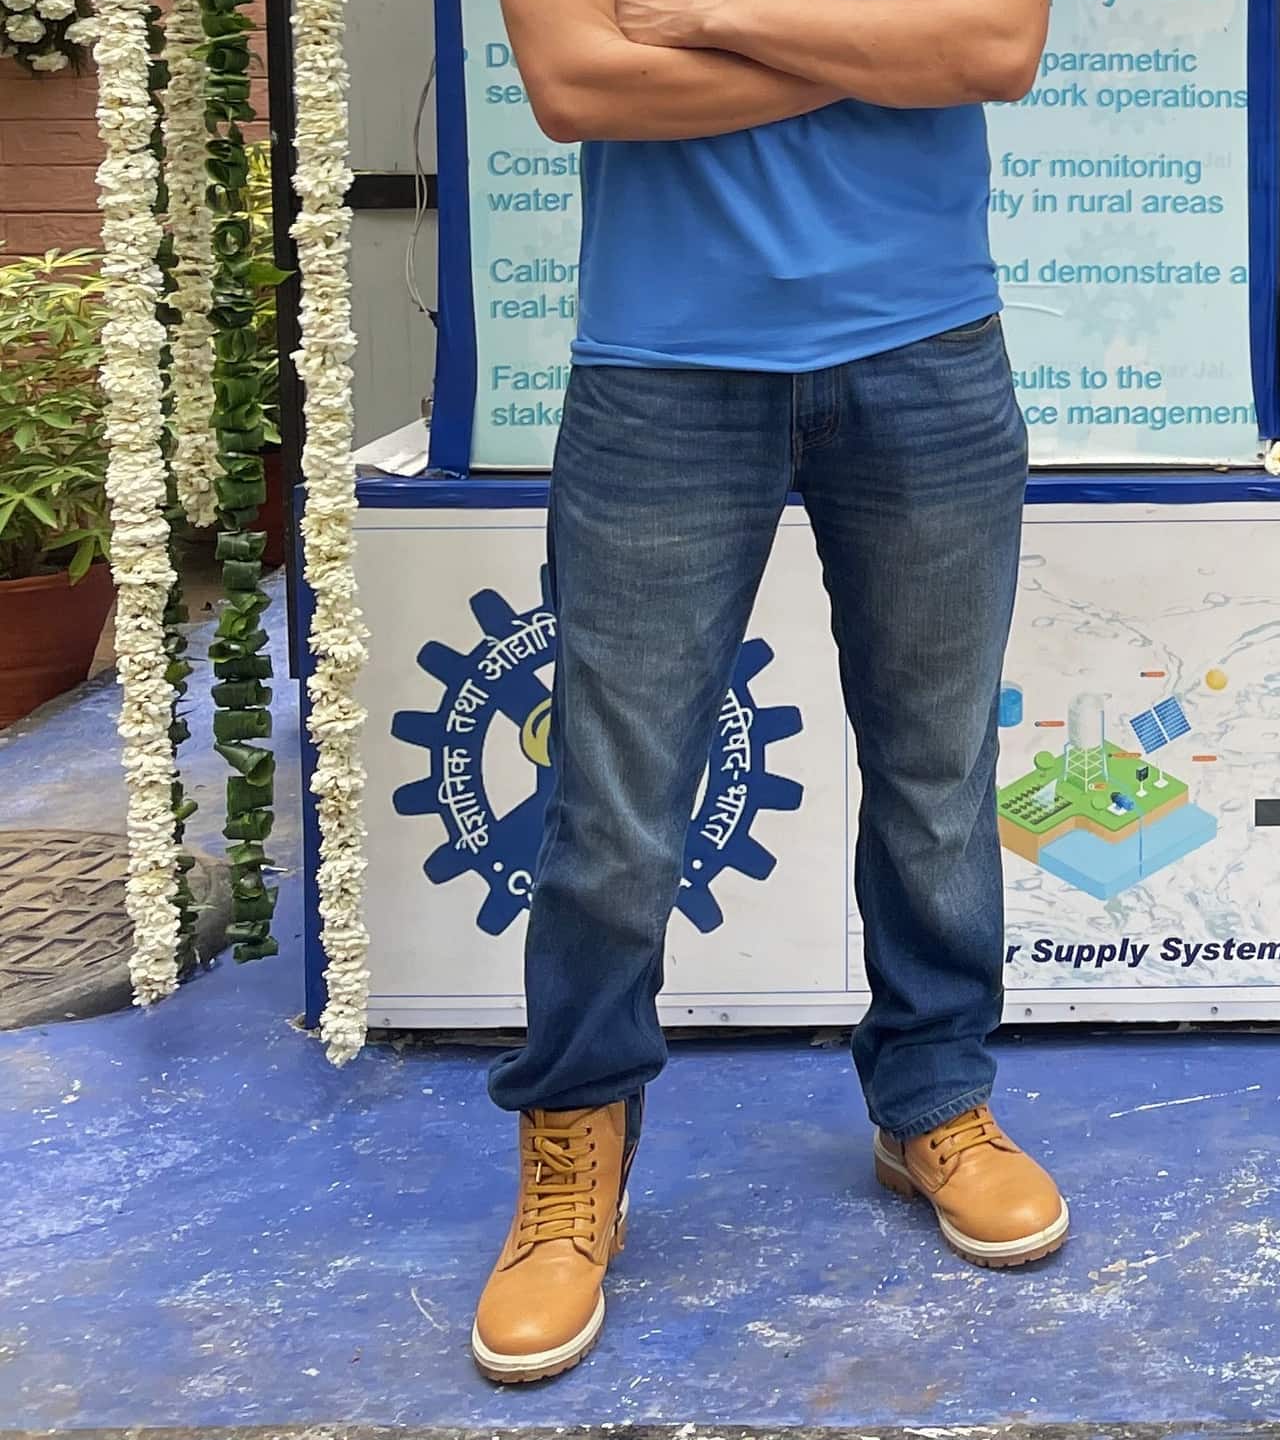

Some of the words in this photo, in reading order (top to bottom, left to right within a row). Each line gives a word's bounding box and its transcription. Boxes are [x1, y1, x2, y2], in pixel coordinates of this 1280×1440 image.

[1042, 48, 1198, 77] parametric
[1097, 83, 1249, 114] operations
[1002, 152, 1041, 177] for
[1050, 154, 1201, 184] monitoring
[488, 192, 573, 212] water
[1034, 188, 1057, 212] in
[1068, 189, 1132, 213] rural
[1142, 195, 1223, 213] areas
[489, 257, 579, 283] Calibr
[996, 259, 1029, 283] nd
[1038, 259, 1215, 284] demonstrate
[1230, 266, 1247, 284] a
[490, 295, 577, 319] real-ti
[492, 365, 569, 390] Facili
[1011, 365, 1071, 389] sults
[1080, 366, 1107, 389] to
[1117, 365, 1162, 389] the
[446, 678, 489, 733] तथा
[1032, 938, 1149, 968] Supply
